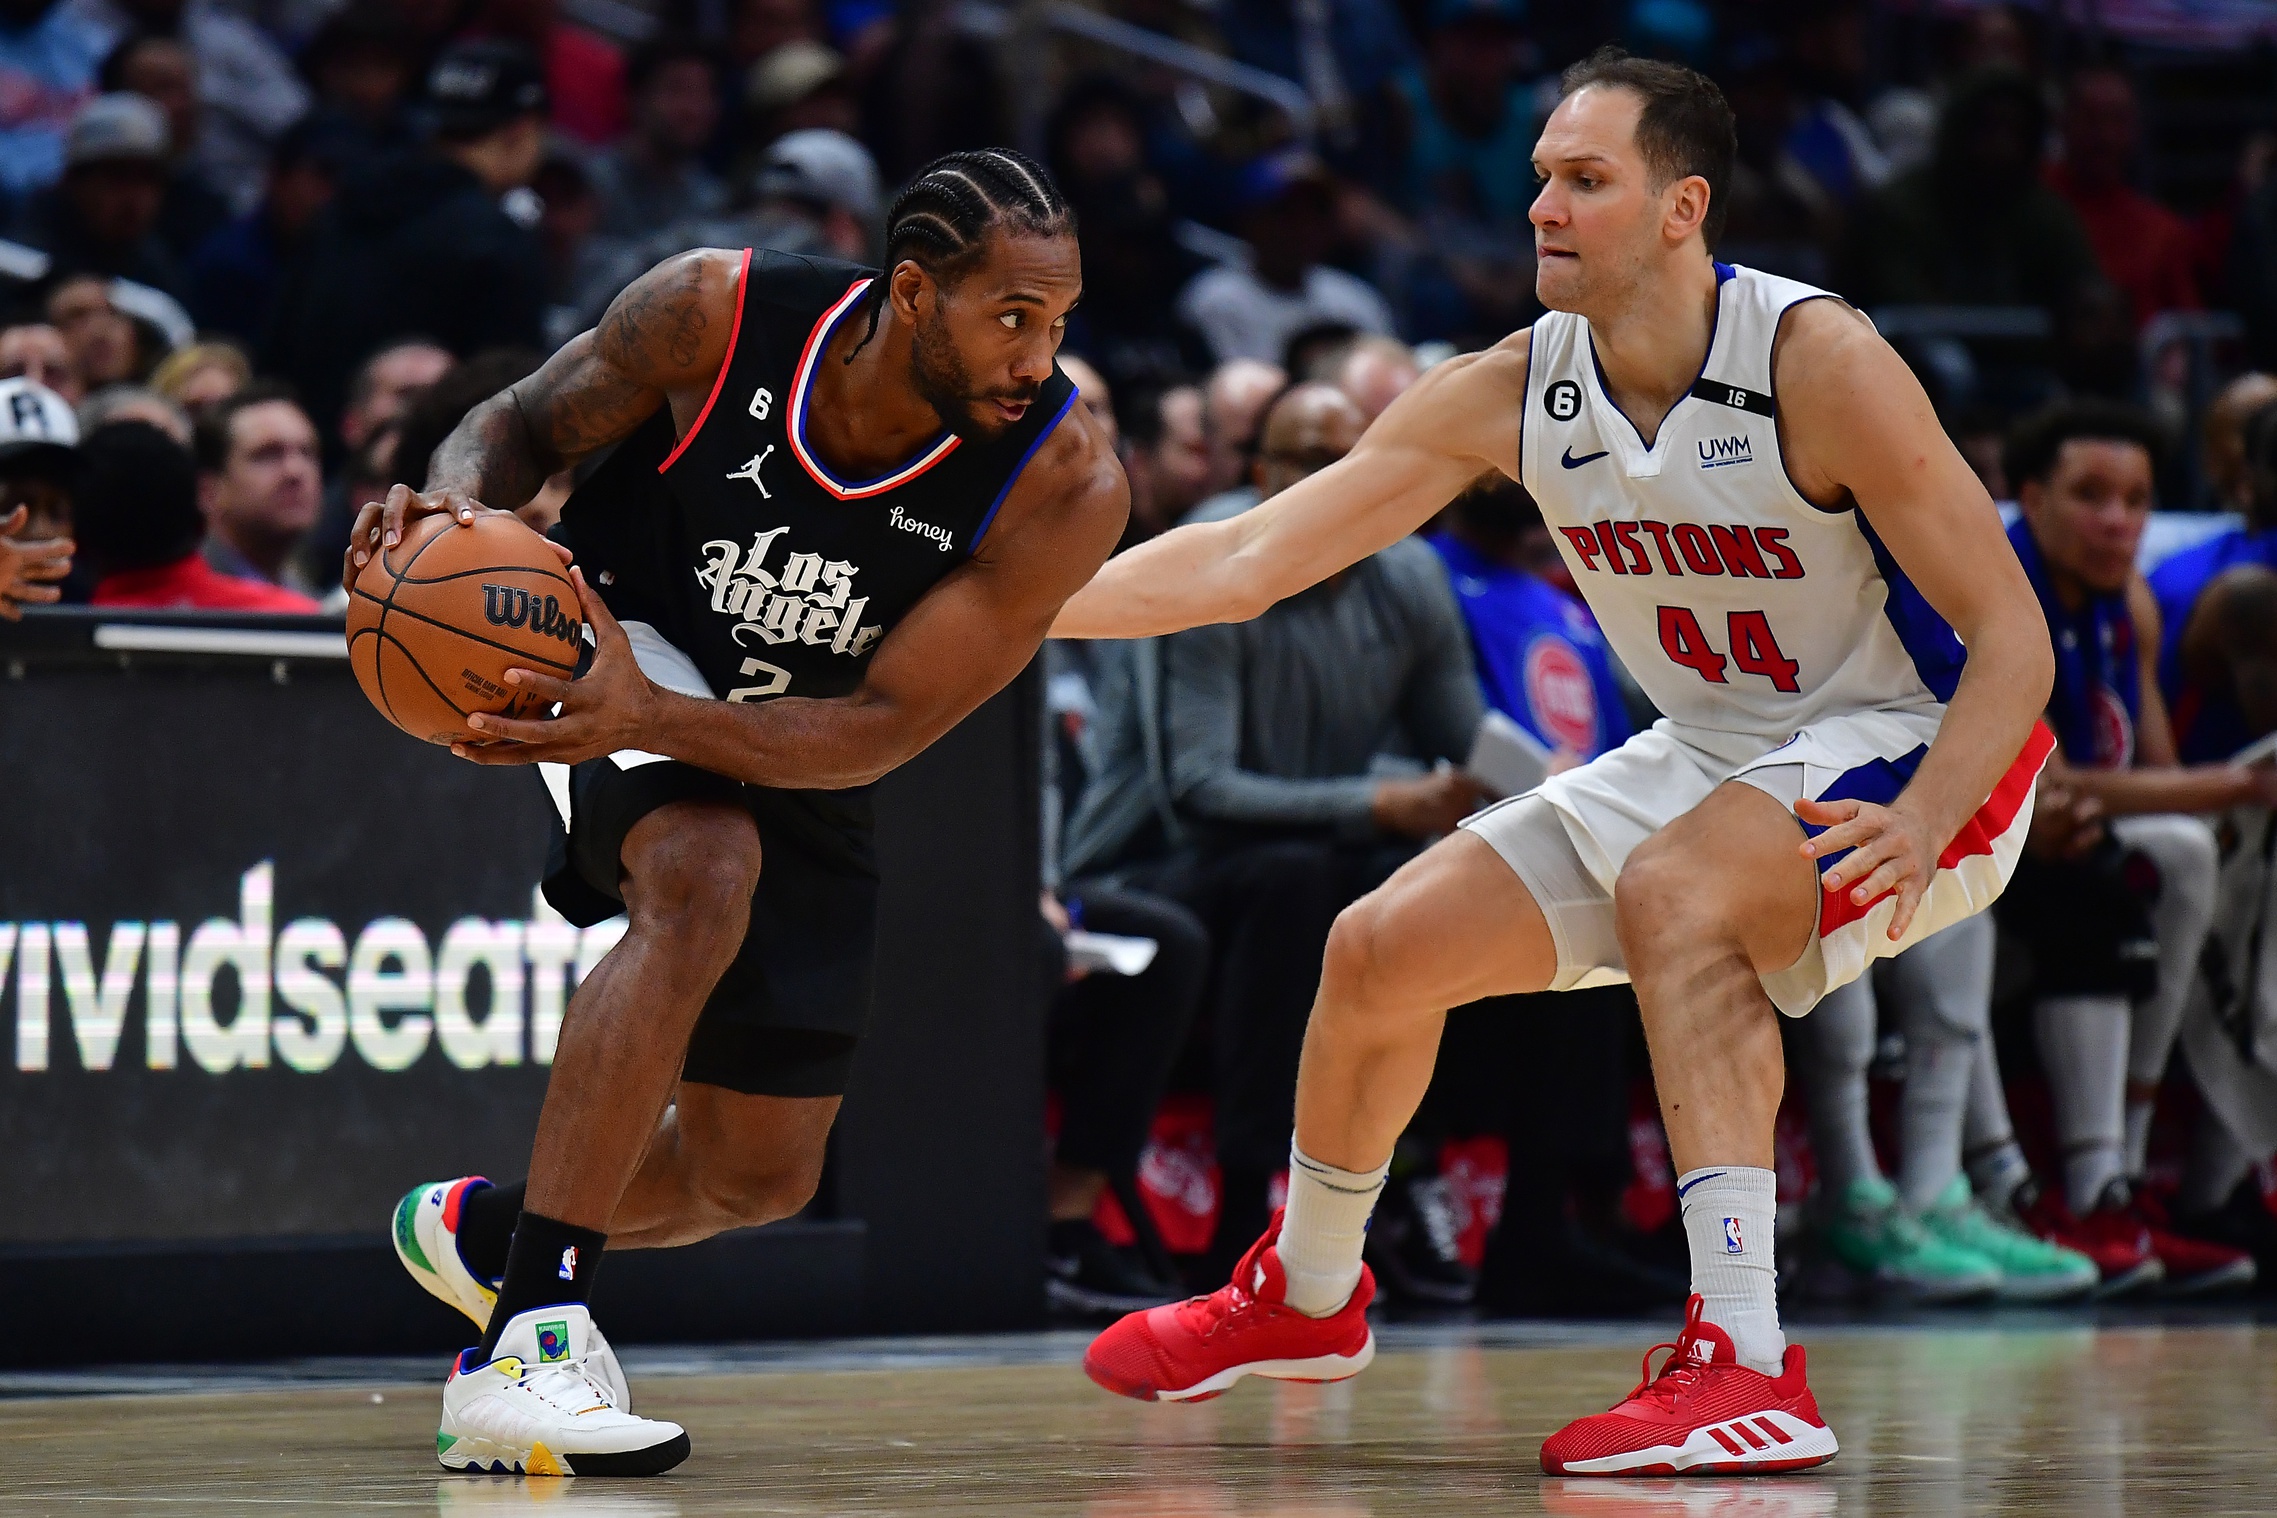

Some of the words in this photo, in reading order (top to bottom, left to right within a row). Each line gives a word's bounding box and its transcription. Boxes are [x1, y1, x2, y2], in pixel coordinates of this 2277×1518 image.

[748, 387, 773, 421] 6
[1552, 386, 1576, 416] 6
[1726, 388, 1747, 408] 16
[1698, 434, 1752, 460] UWM
[889, 506, 953, 552] honey
[1558, 519, 1806, 580] PISTONS
[733, 526, 860, 610] Los
[693, 540, 884, 657] Angele
[1656, 604, 1801, 694] 44
[726, 657, 793, 703] 2
[0, 858, 630, 1075] ividseat
